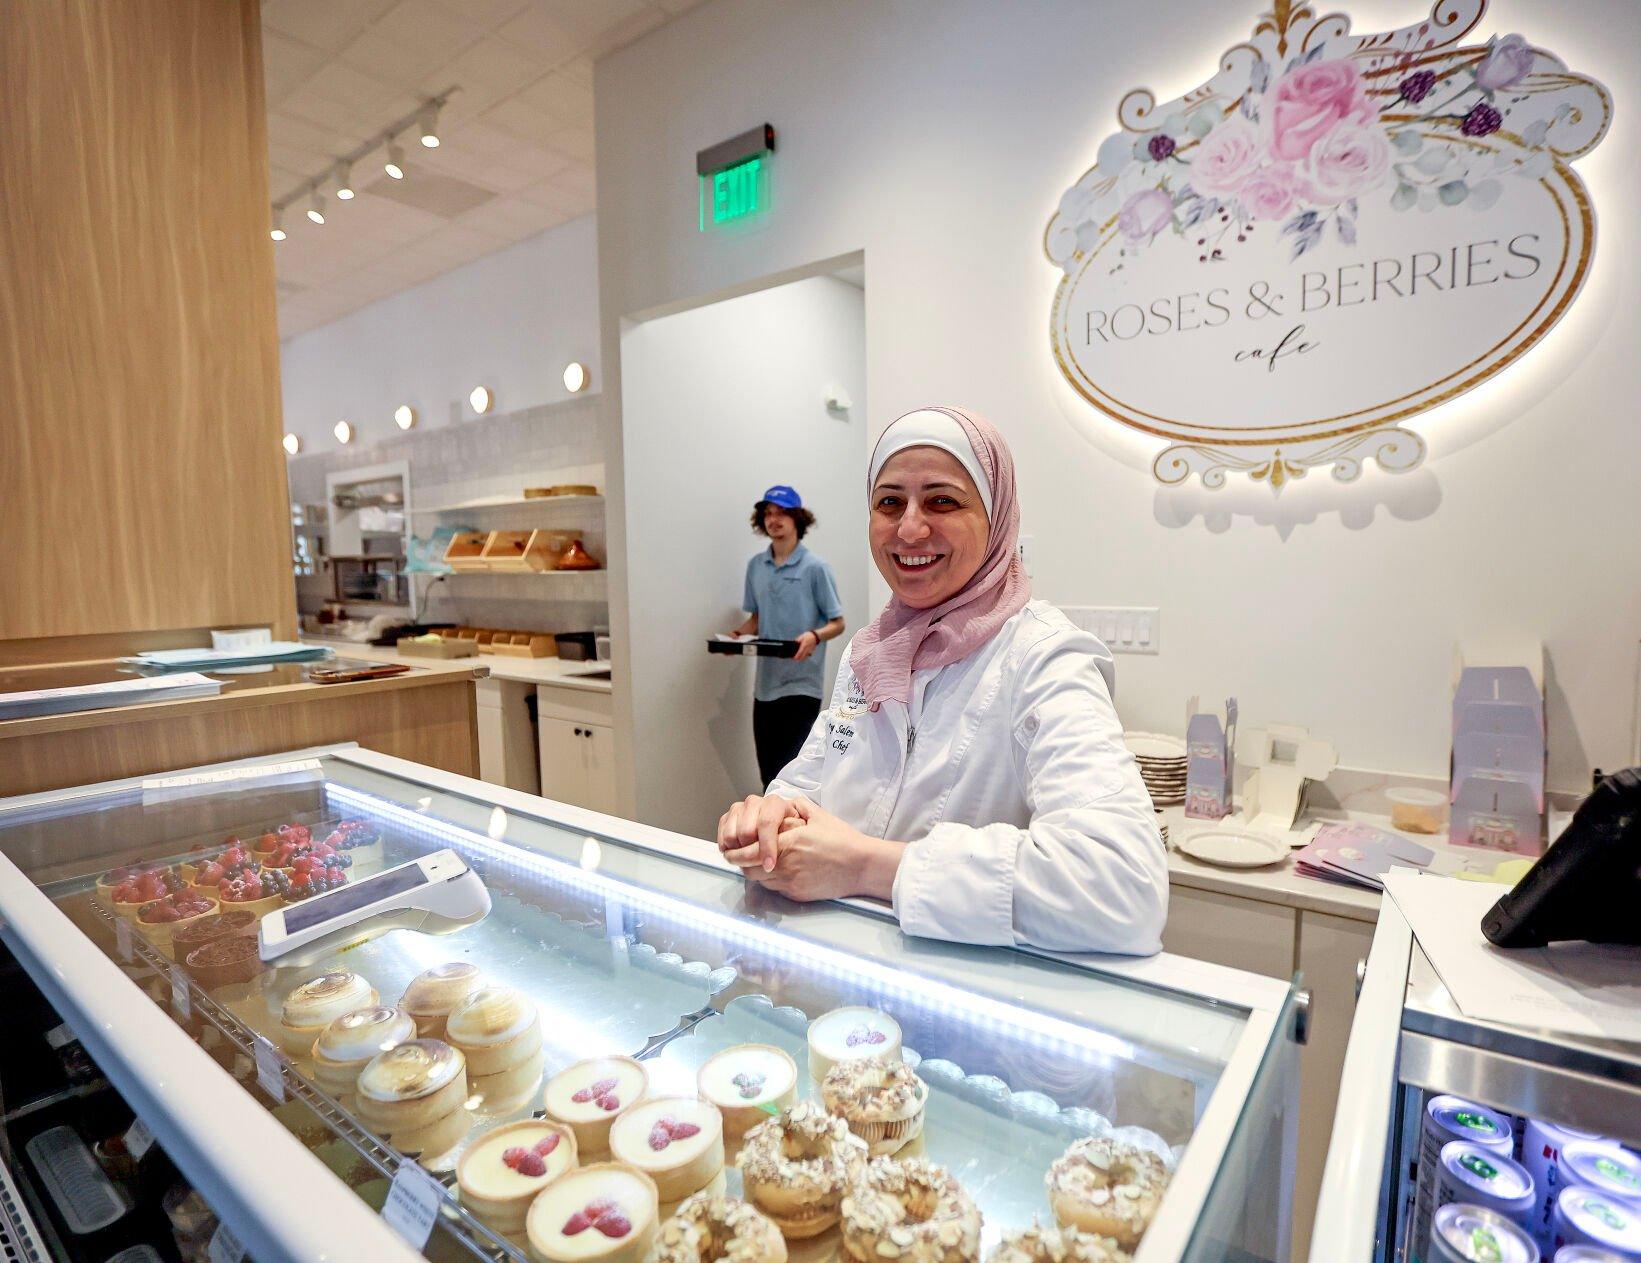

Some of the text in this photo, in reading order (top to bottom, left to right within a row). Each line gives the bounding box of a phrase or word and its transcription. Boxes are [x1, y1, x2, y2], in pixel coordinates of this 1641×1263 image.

[713, 159, 760, 222] EXIT
[1086, 233, 1541, 345] ROSES & BERRIES
[1234, 323, 1321, 373] cafe
[832, 739, 851, 755] Chef
